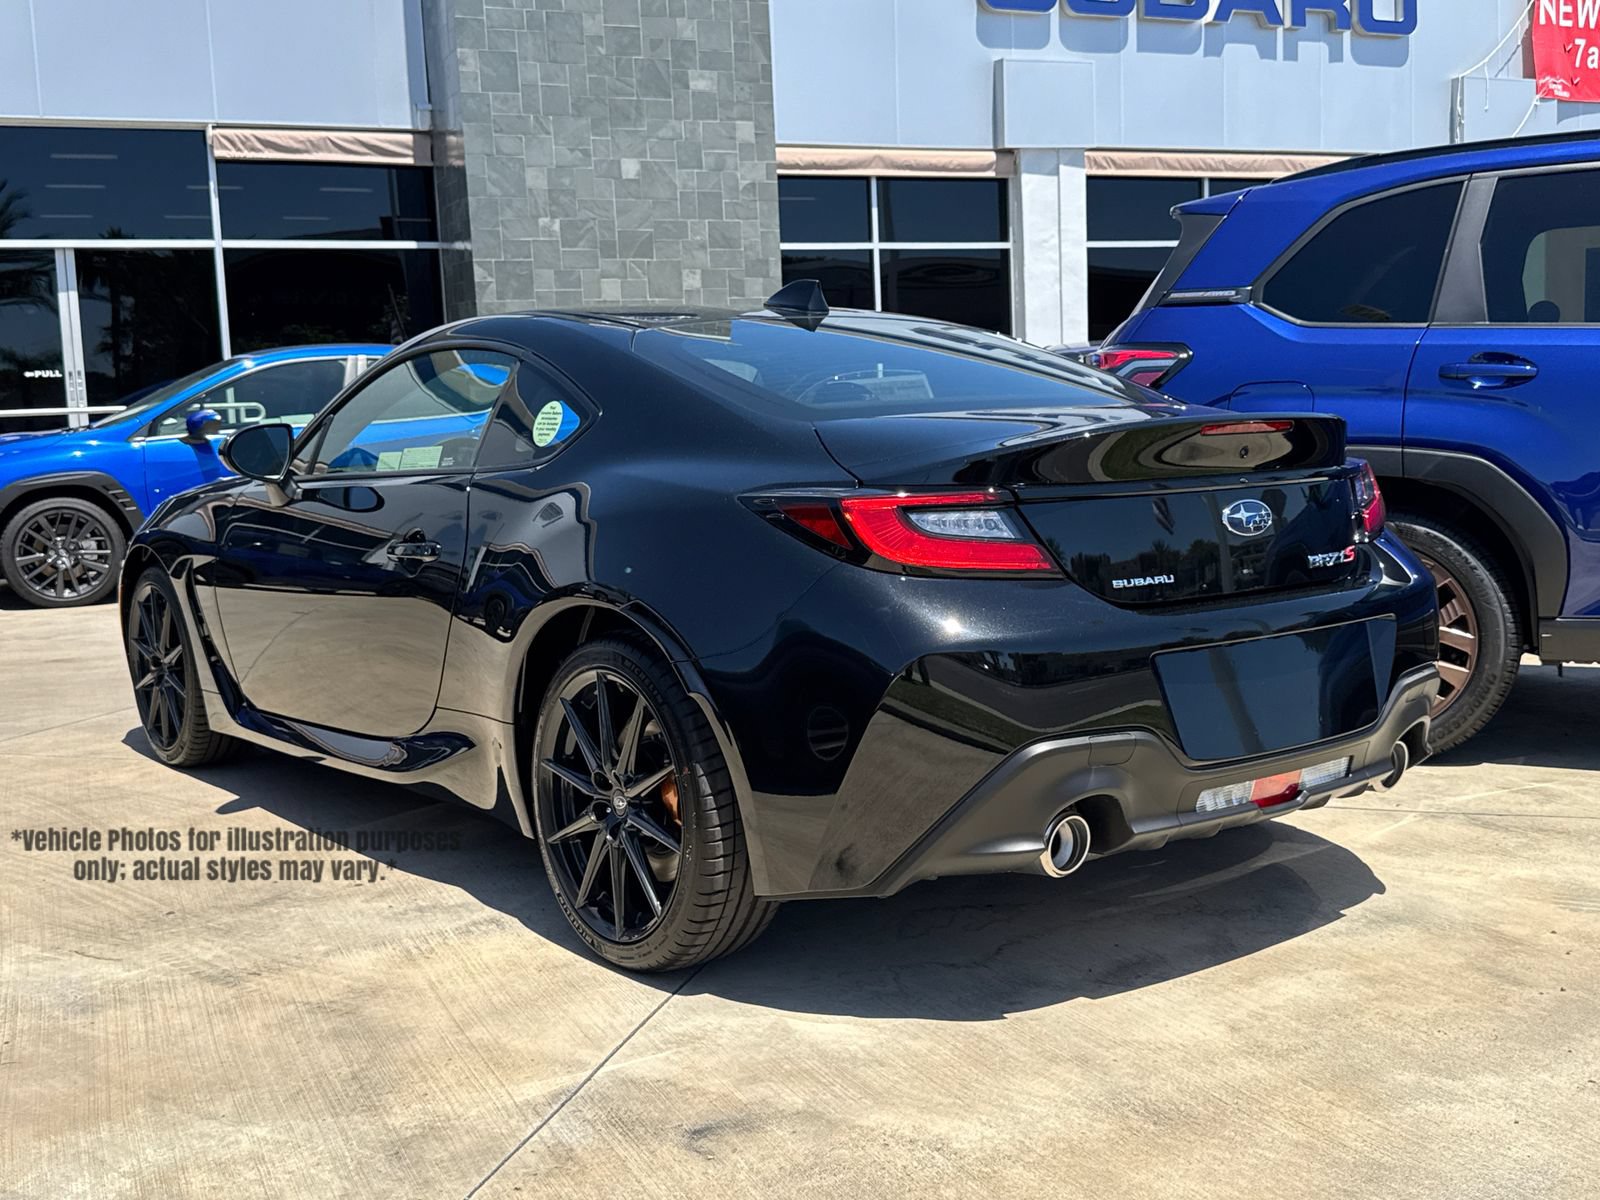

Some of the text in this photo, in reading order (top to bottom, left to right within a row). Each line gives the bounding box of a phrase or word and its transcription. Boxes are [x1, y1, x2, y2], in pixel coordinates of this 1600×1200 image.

[34, 369, 63, 378] PULL
[1112, 574, 1175, 588] SUBARU
[623, 659, 663, 704] MICHELIN
